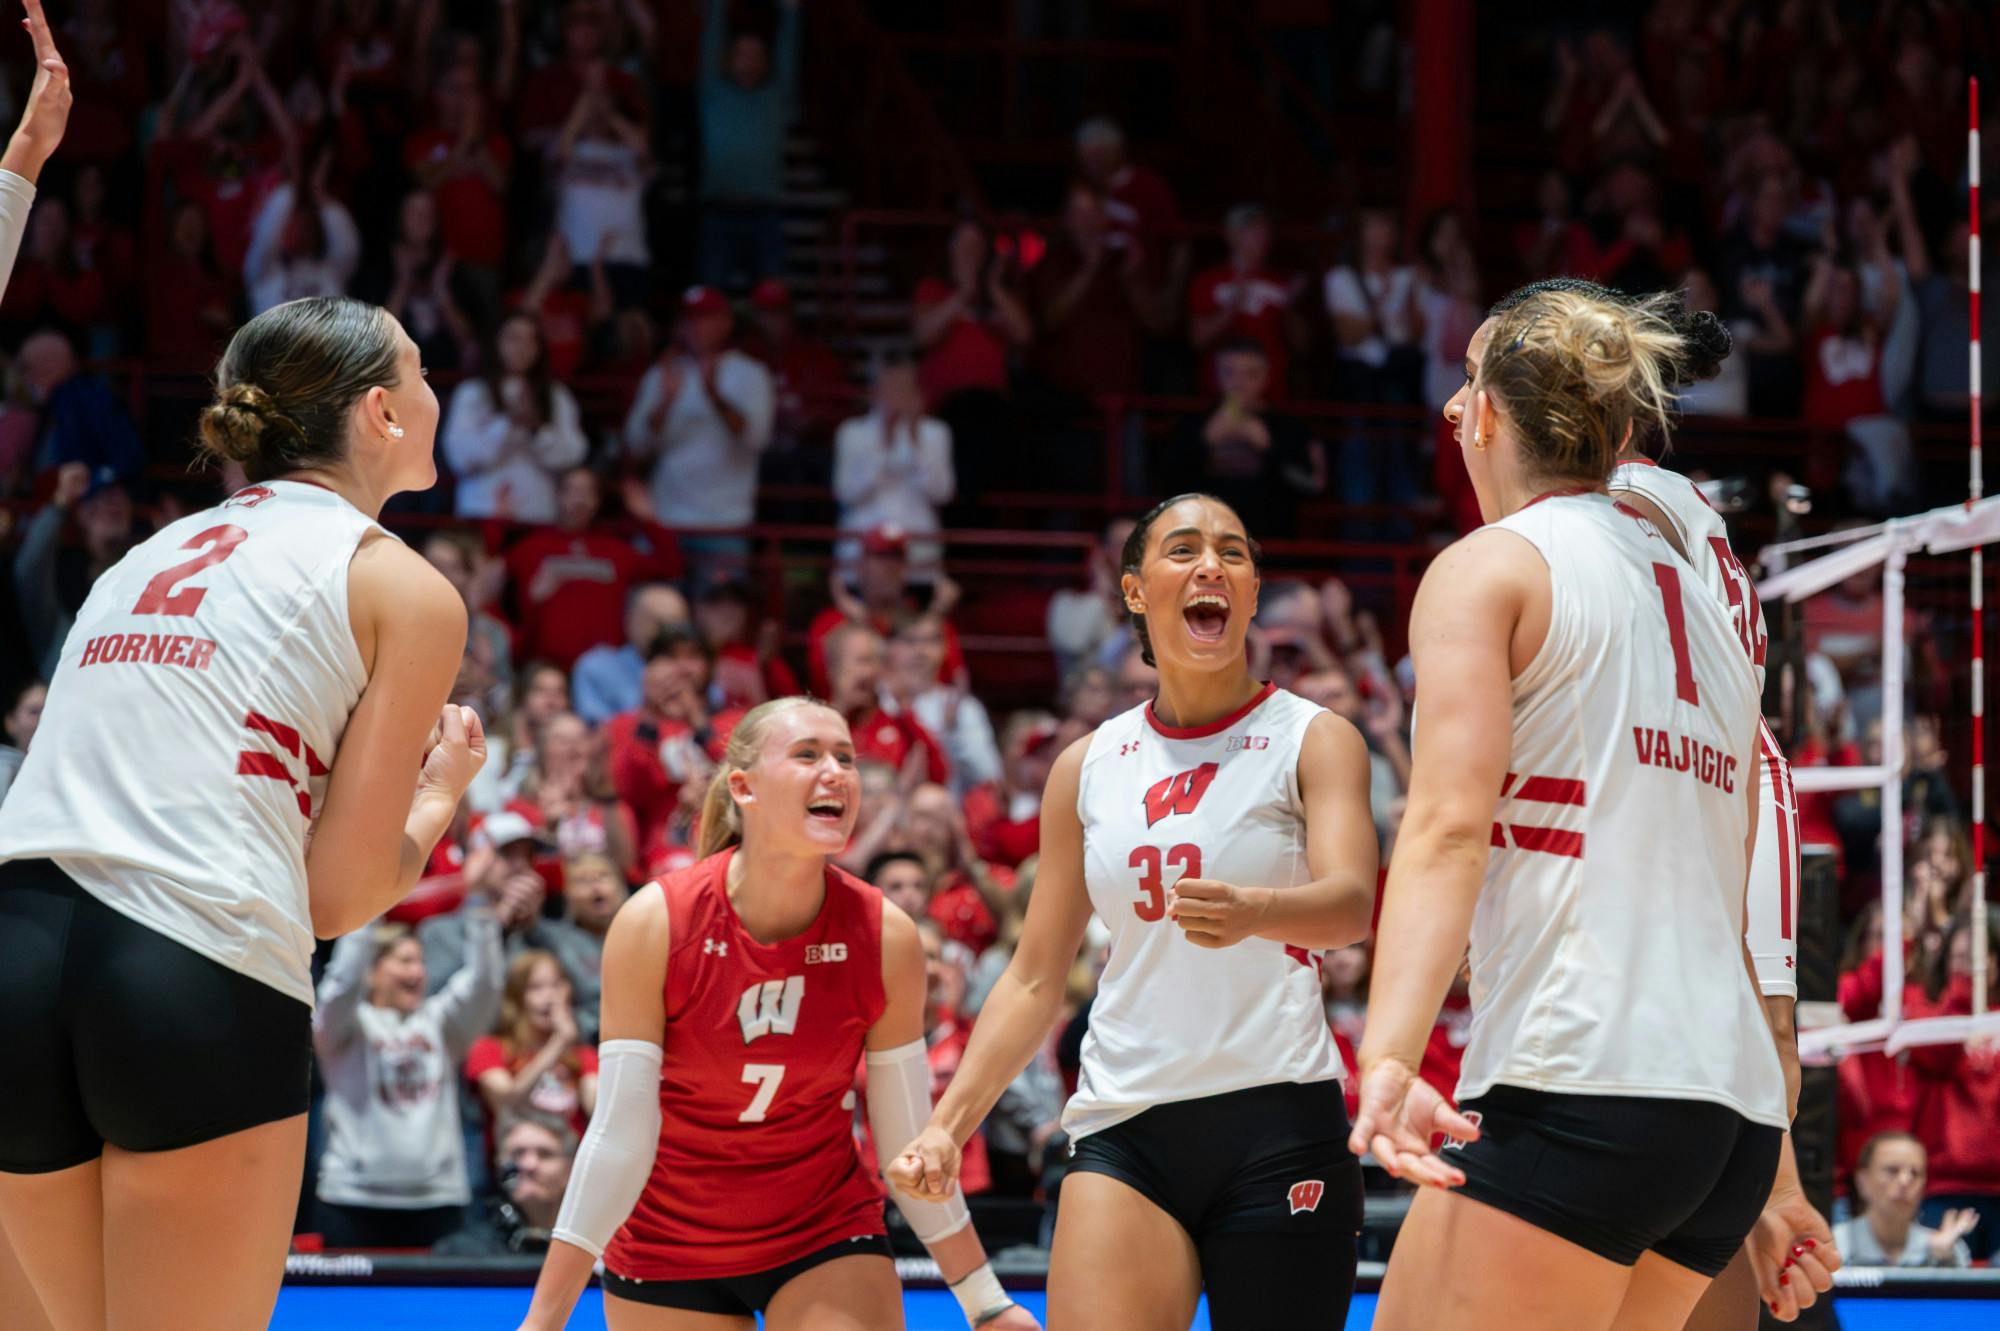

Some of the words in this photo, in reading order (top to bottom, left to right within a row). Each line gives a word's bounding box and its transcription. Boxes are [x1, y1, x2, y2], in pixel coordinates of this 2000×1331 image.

[131, 523, 249, 618] 2
[78, 633, 218, 671] HORNER
[1652, 561, 1700, 707] 1
[1142, 762, 1219, 829] W
[736, 975, 805, 1045] W
[738, 1063, 786, 1122] 7
[1286, 1179, 1325, 1216] W
